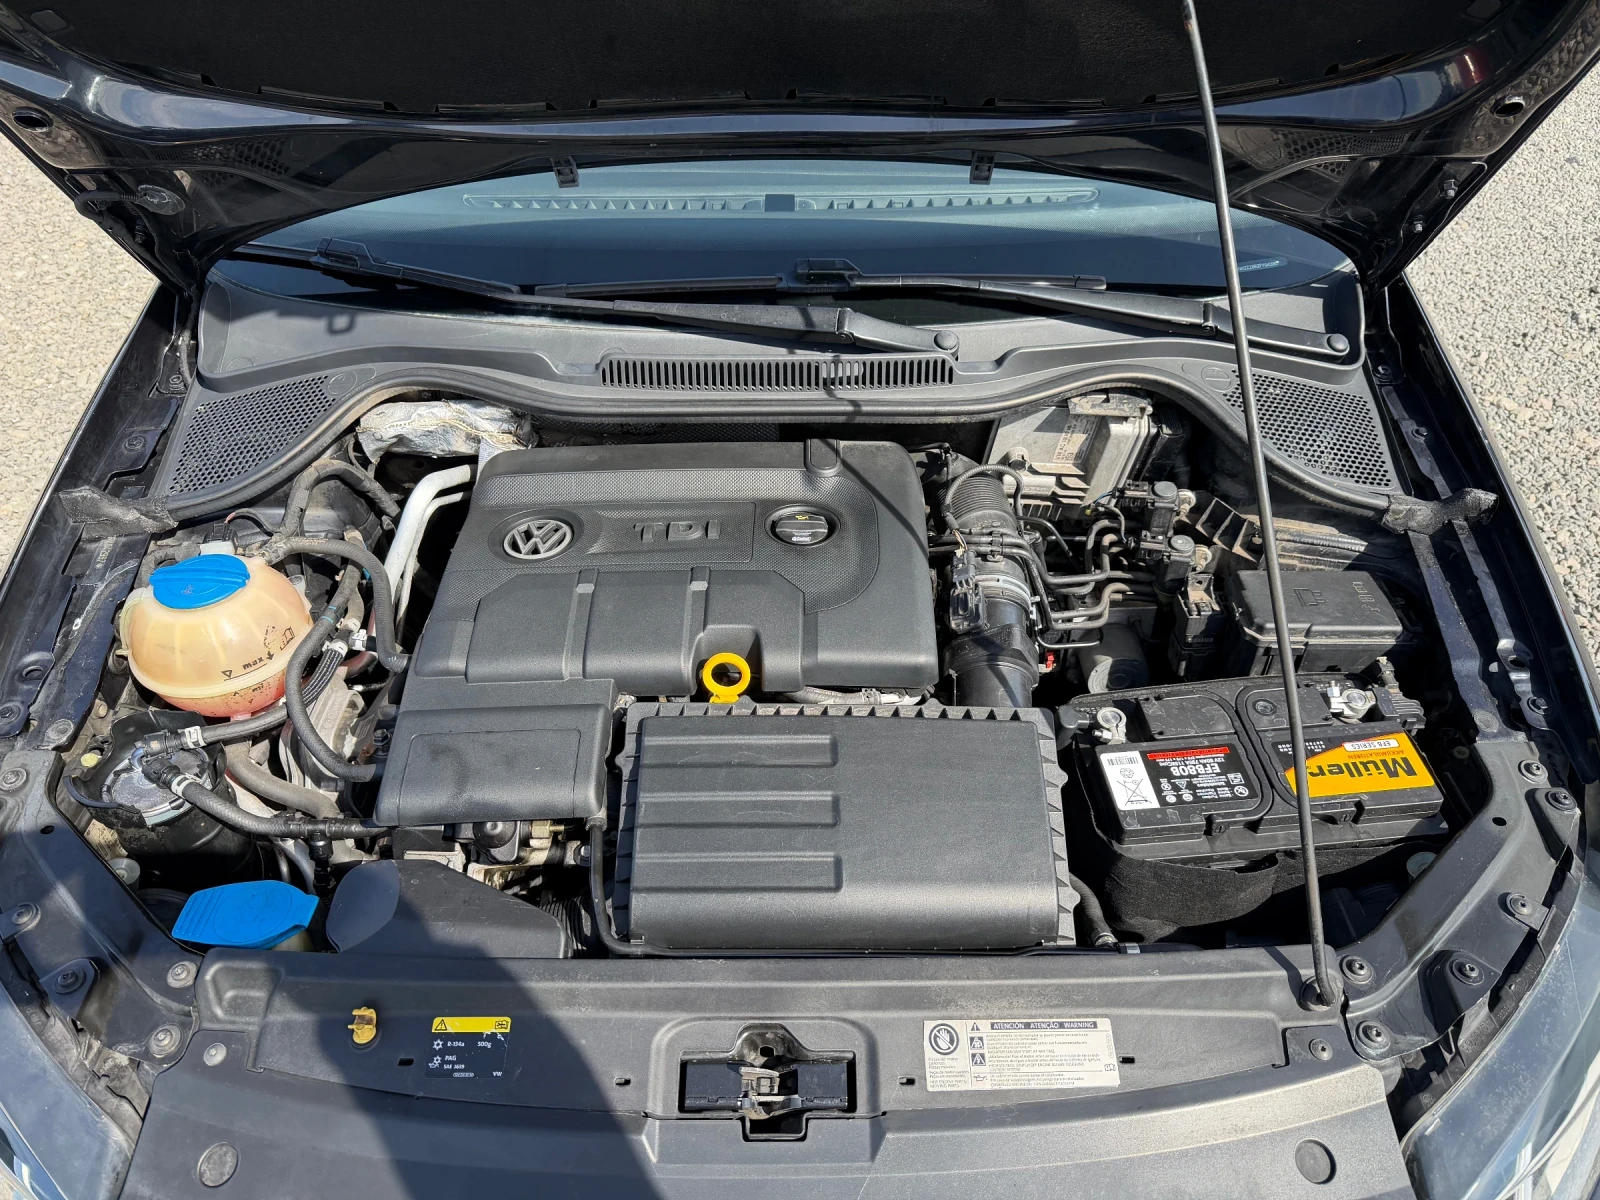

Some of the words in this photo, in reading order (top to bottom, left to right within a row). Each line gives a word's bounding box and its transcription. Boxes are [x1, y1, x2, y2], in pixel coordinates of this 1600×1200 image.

[634, 520, 721, 543] TDI
[242, 656, 265, 670] max
[1351, 741, 1377, 750] SERIES
[1348, 750, 1404, 760] AKKUMULATOREN
[1170, 762, 1222, 777] EFB80B
[1308, 756, 1418, 779] Müller
[993, 1021, 1025, 1030] ATENCIÓN
[1030, 1020, 1059, 1030] ATENÇÃO
[1063, 1021, 1094, 1029] WARNING
